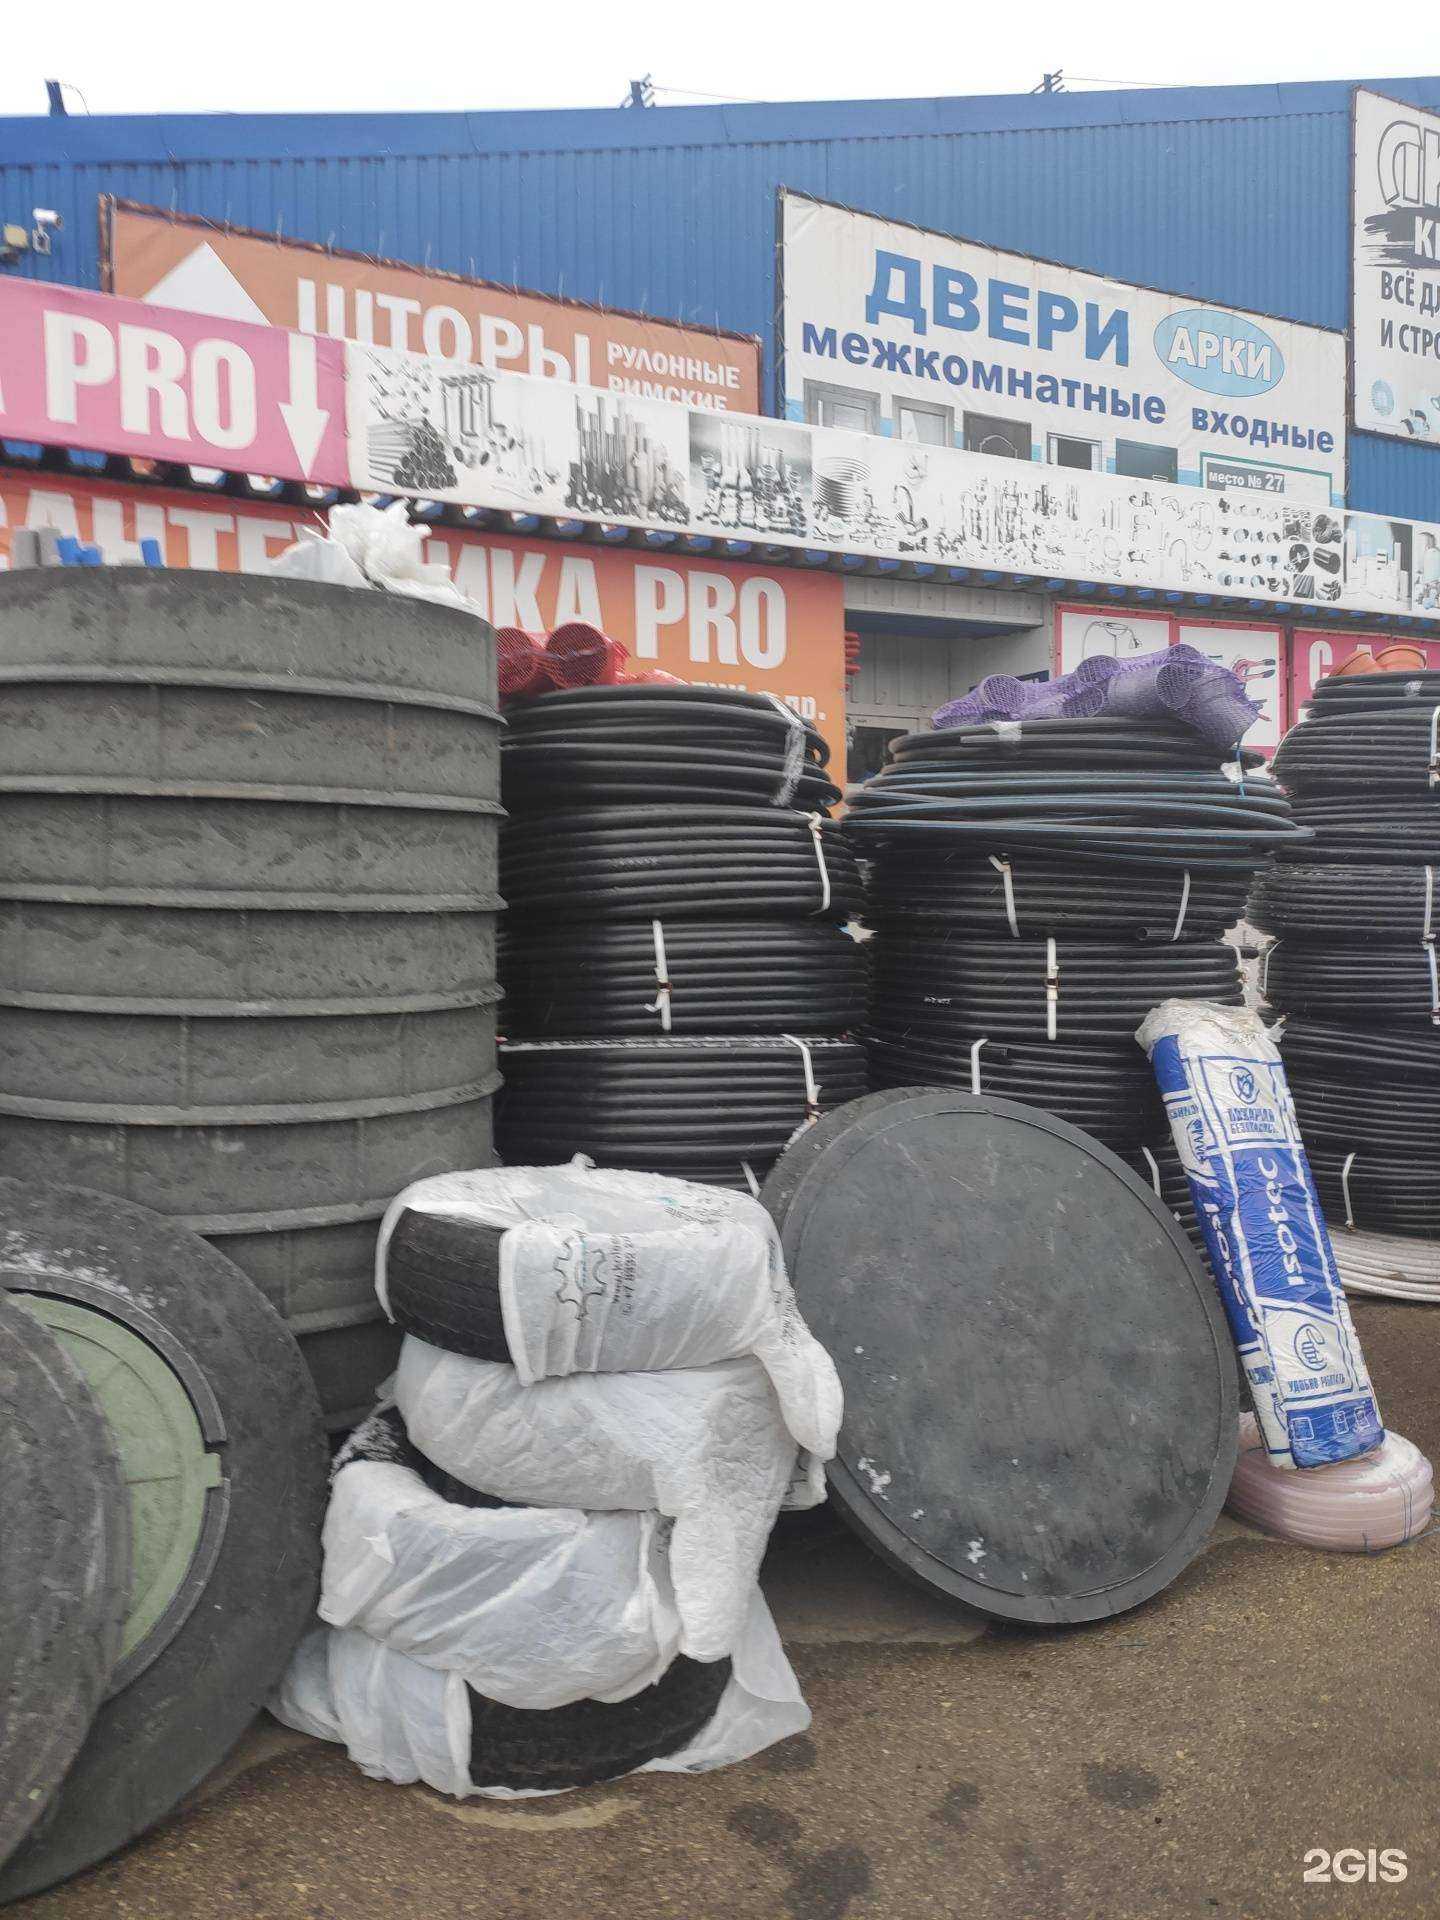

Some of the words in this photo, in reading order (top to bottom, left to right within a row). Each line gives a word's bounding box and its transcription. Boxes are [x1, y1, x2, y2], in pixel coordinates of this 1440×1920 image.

[865, 249, 1129, 368] ДВЕРИ
[1381, 270, 1415, 307] ВСЁ
[298, 278, 591, 388] ШТОРЫ
[1167, 326, 1272, 382] АРКИ
[1381, 318, 1393, 349] И
[43, 309, 258, 450] PRO
[607, 340, 741, 390] РУЛОННЫЕ
[802, 322, 1167, 425] межкомнатные
[1192, 407, 1334, 454] входные
[1208, 472, 1245, 486] место
[1265, 474, 1284, 492] 27
[634, 564, 787, 670] PRO
